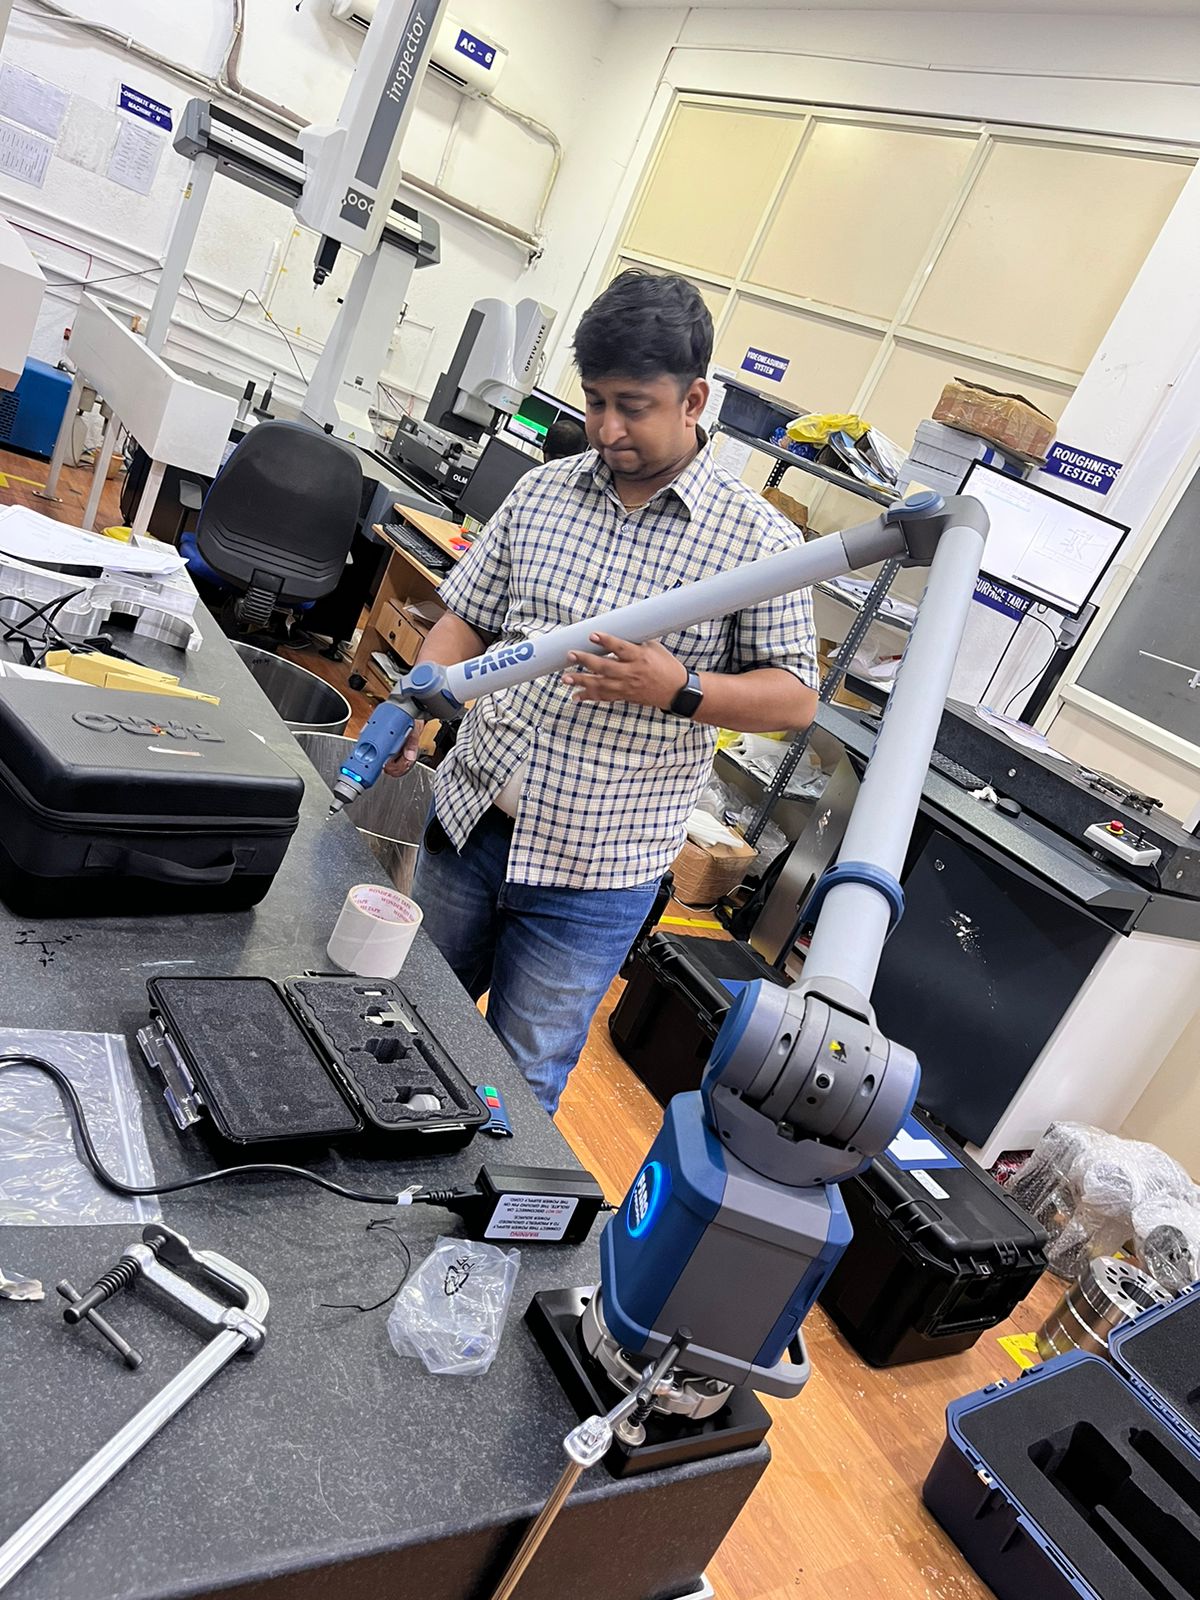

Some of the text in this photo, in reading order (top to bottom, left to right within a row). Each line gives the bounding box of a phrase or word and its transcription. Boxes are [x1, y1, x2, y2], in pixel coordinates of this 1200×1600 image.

[386, 12, 426, 103] inspector
[459, 37, 476, 53] AC
[484, 52, 493, 64] 6
[524, 324, 547, 372] OPTIV LITE
[754, 362, 775, 376] SYSTEM
[1052, 446, 1121, 479] ROUGHNESS
[1058, 462, 1103, 487] TESTER
[464, 642, 534, 680] FARO
